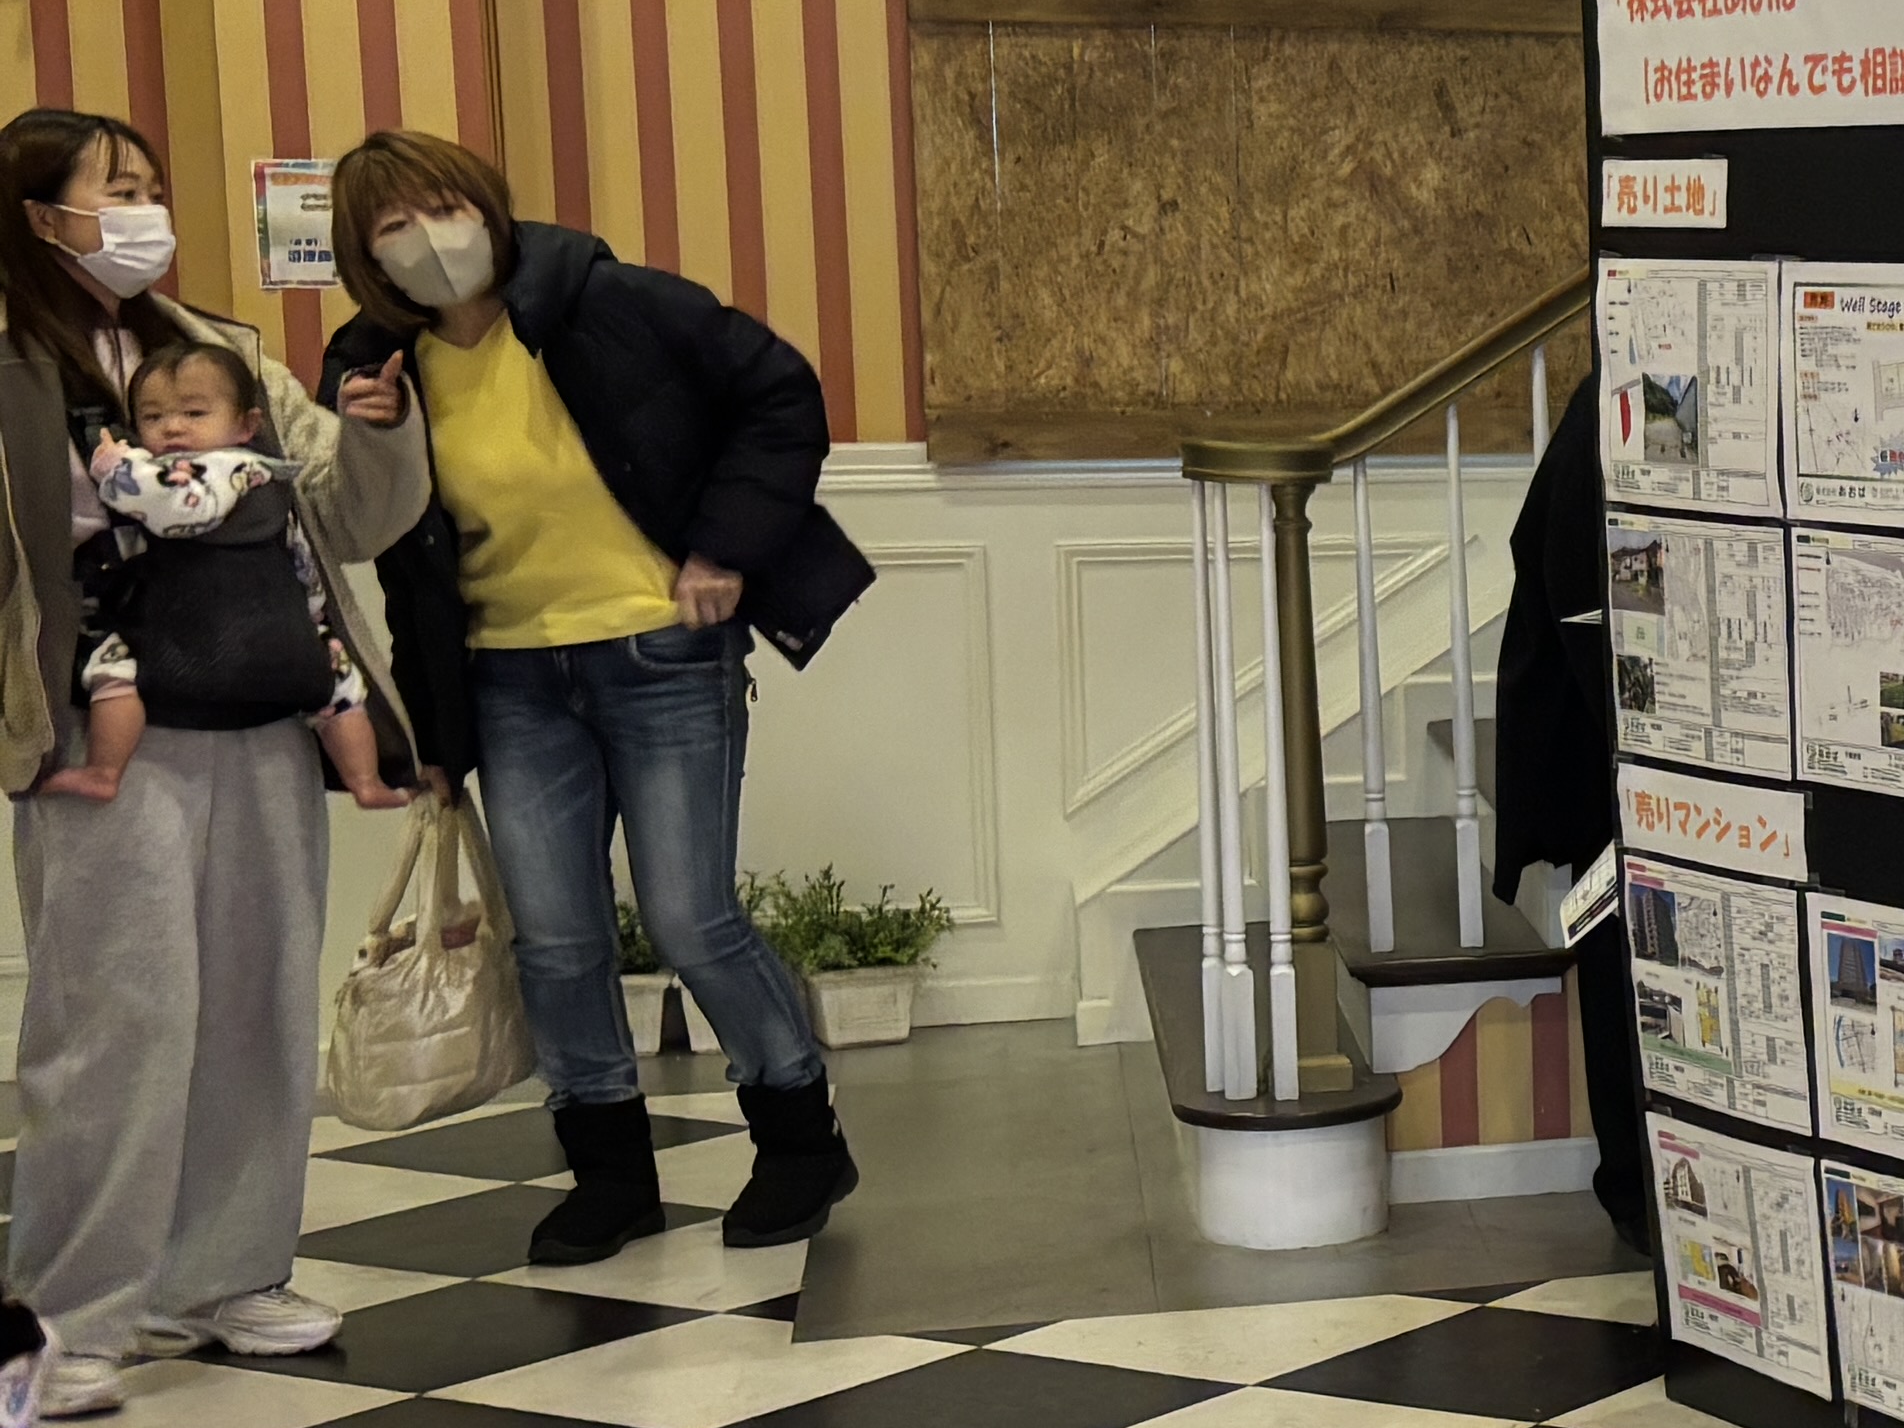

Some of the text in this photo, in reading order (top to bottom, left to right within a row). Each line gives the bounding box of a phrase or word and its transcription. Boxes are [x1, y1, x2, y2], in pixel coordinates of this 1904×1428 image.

[1605, 173, 1718, 217] 「売り土地」
[1625, 787, 1791, 859] 「売りマンション」
